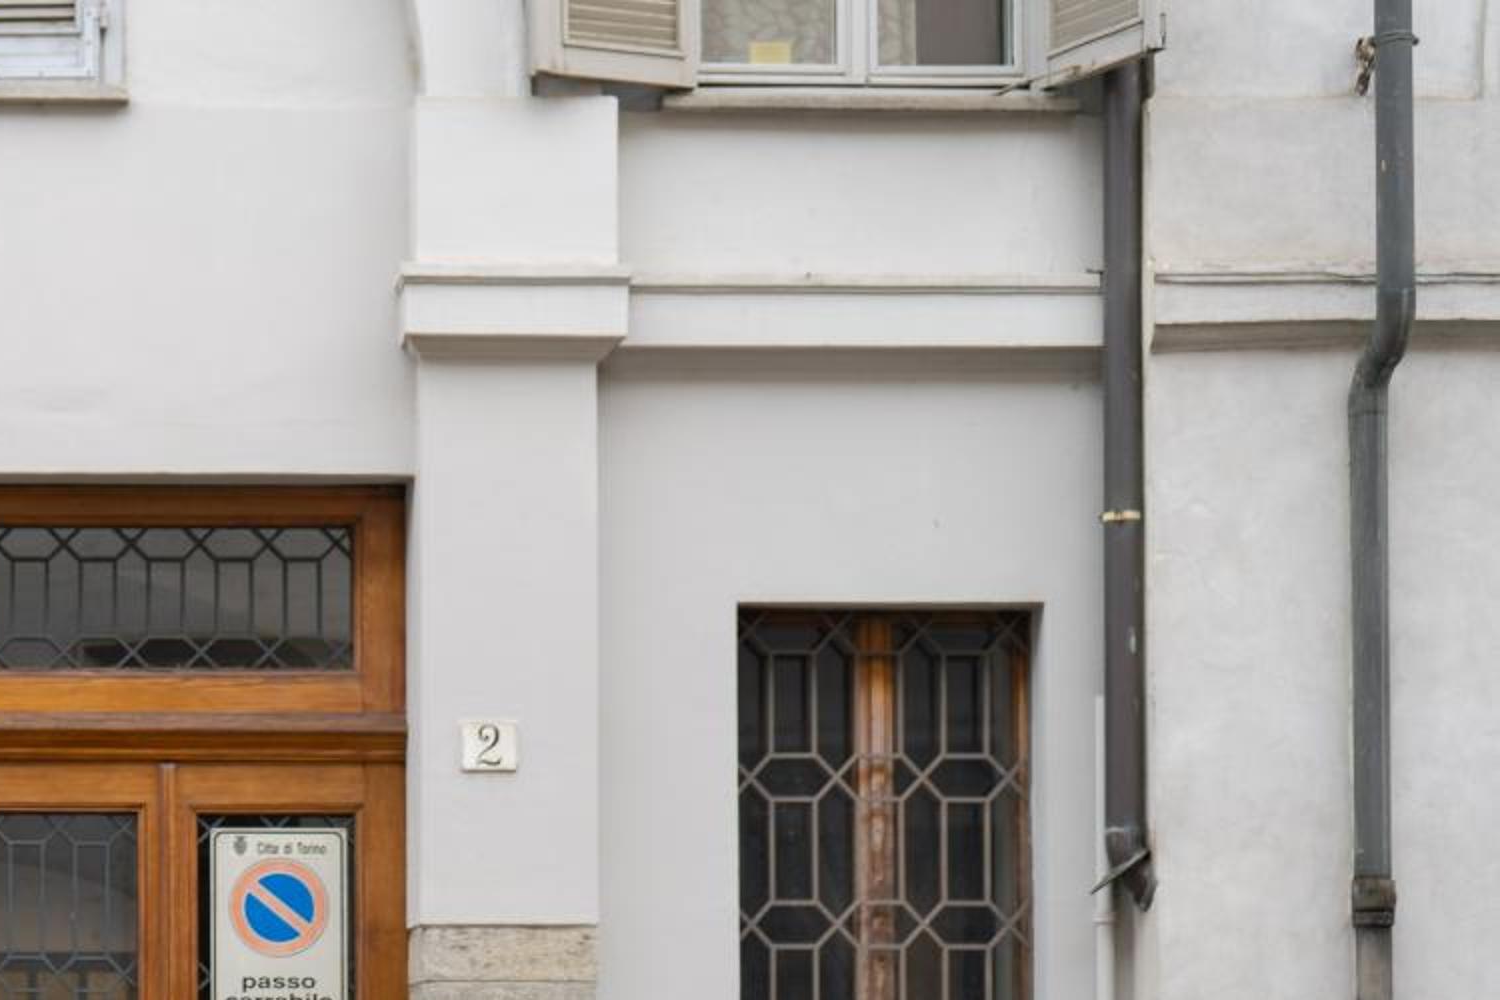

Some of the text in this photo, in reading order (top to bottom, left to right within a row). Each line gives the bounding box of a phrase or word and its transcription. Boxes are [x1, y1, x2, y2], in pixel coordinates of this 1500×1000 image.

[476, 724, 502, 766] 2
[297, 841, 327, 856] Torino
[242, 975, 317, 993] passo
